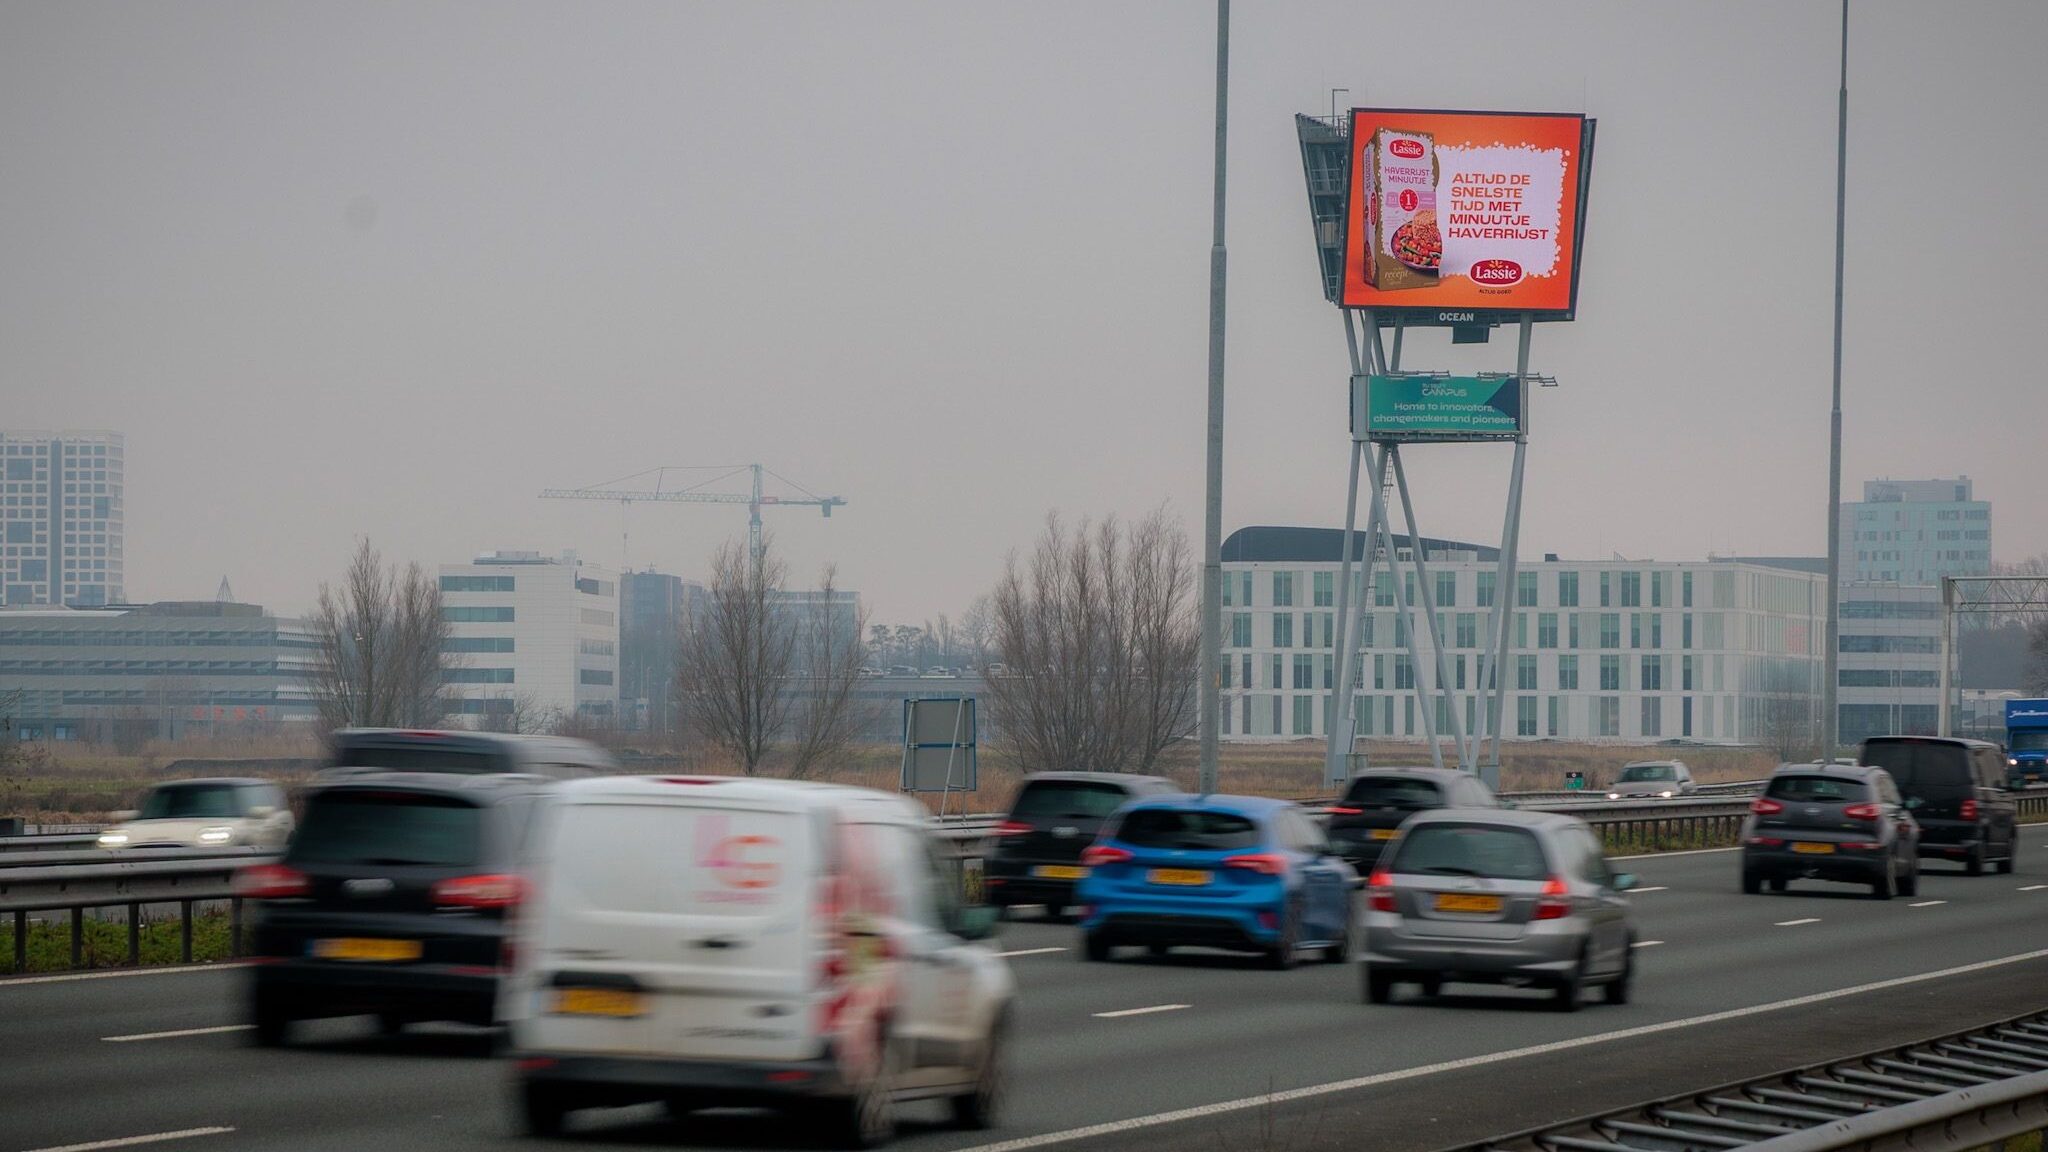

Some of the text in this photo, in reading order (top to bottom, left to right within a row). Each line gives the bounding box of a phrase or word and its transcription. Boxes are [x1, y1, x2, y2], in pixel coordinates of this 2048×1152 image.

[1393, 143, 1422, 155] Lassie
[1384, 166, 1430, 176] HAVERRIJST
[1388, 175, 1427, 185] MINUUTJE
[1452, 173, 1531, 185] ALTIJD DE
[1451, 186, 1523, 198] SNELSTE
[1405, 193, 1412, 206] 1
[1450, 200, 1522, 212] TIJD MET
[1449, 214, 1530, 225] MINUUTJE
[1448, 227, 1549, 239] HAVERRIJST
[1475, 265, 1516, 279] Lassie
[1439, 312, 1474, 322] OCEAN
[1422, 388, 1467, 397] CAMPUS
[1394, 402, 1495, 413] Home to innovators,
[1373, 413, 1516, 424] changemakers and pioneers
